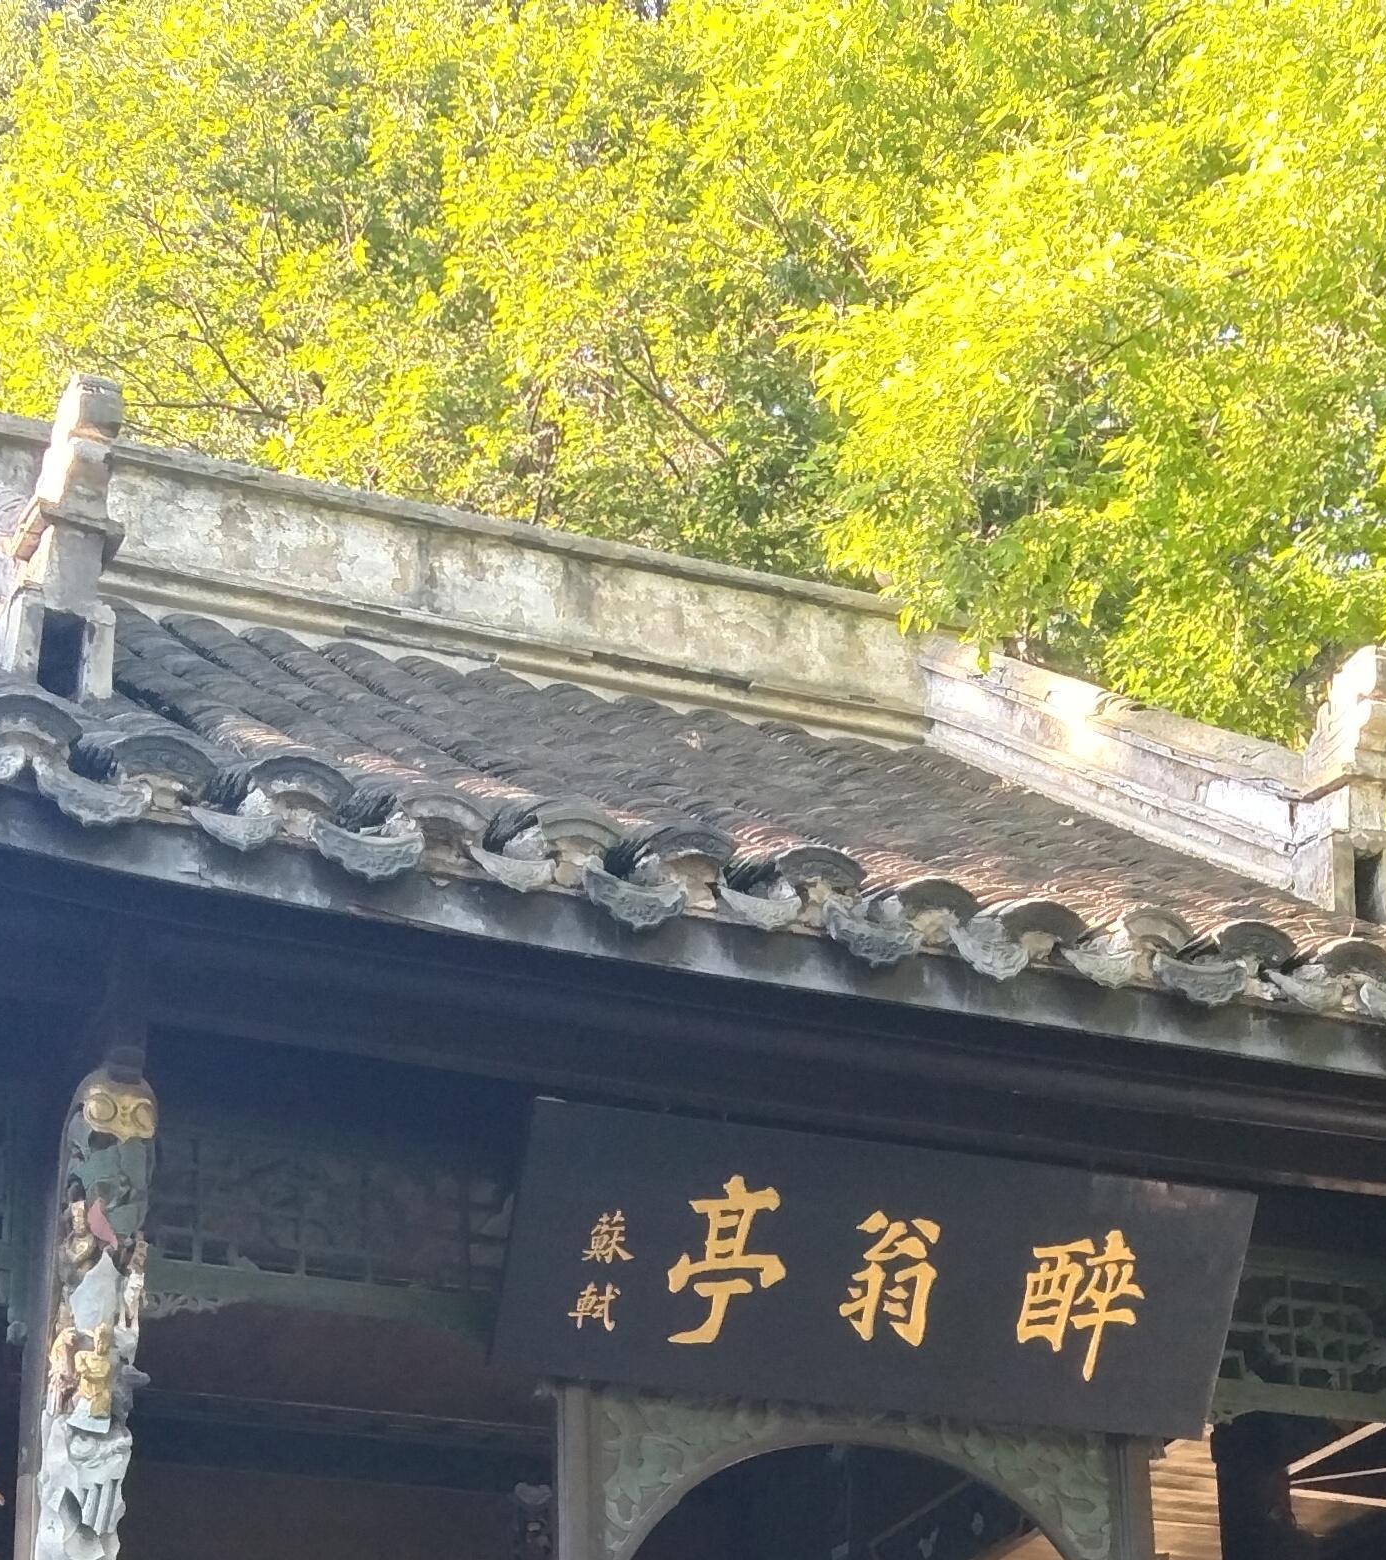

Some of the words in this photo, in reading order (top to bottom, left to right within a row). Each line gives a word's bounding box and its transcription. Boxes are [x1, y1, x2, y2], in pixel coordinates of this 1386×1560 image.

[568, 1210, 634, 1331] 蘇軾
[667, 1174, 1146, 1383] 醉翁亭
